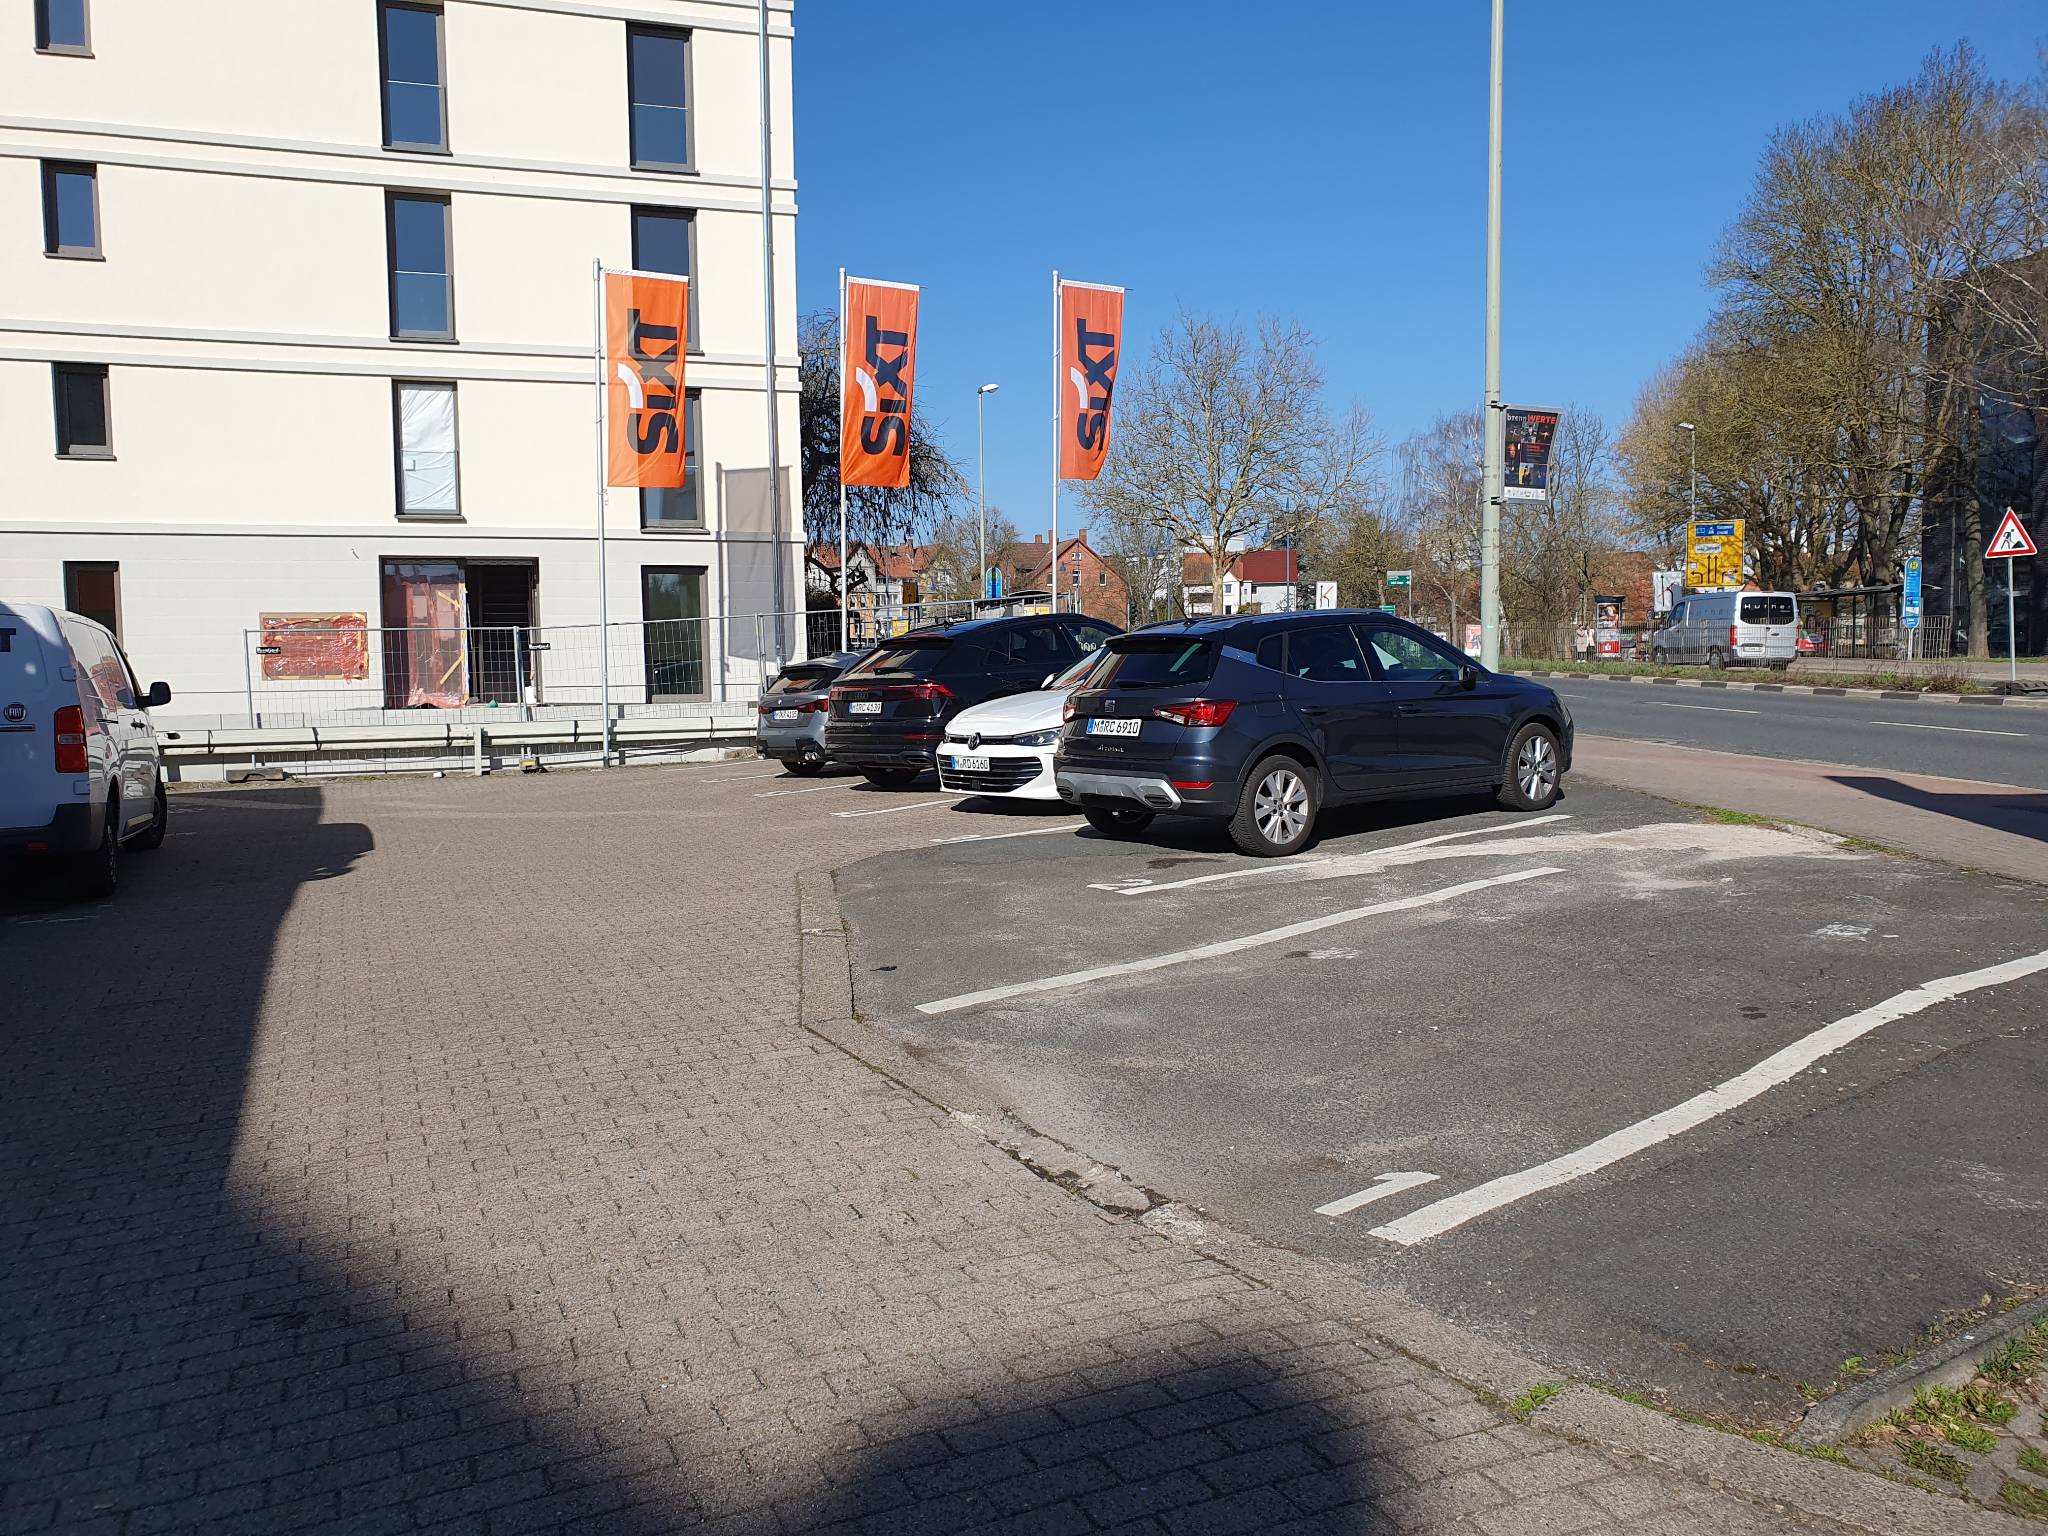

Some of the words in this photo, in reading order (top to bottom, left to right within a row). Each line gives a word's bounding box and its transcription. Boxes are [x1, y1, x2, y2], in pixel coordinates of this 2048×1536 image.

[617, 308, 679, 454] SIXT
[855, 315, 909, 457] SIXT
[1070, 317, 1115, 452] SIXT
[1116, 721, 1139, 734] 6910
